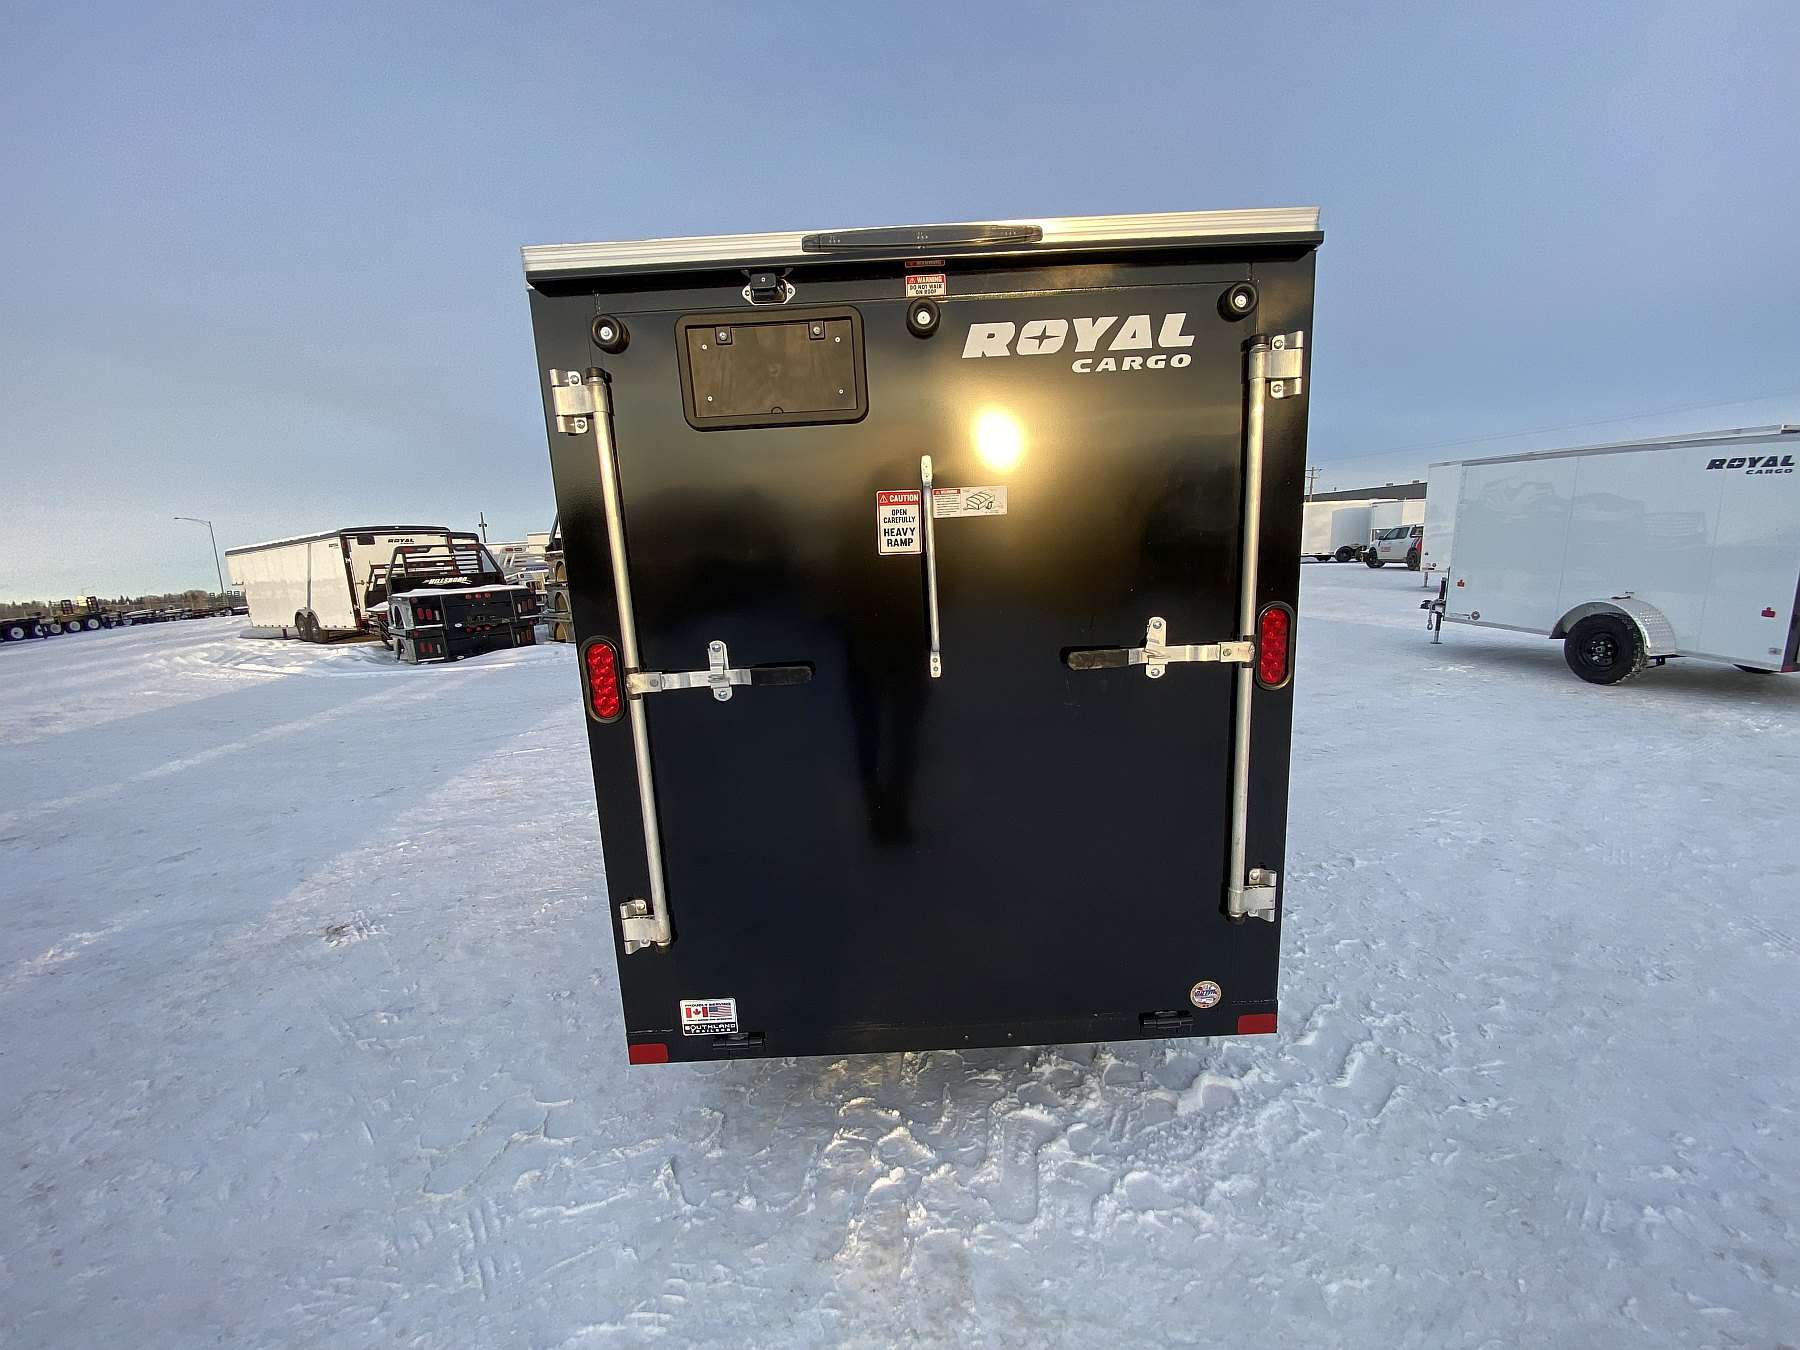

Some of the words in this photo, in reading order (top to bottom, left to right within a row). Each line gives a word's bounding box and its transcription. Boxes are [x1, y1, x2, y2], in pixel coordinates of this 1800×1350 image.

[962, 313, 1195, 359] ROYAL
[1071, 353, 1192, 373] CARGO
[1706, 455, 1795, 470] ROYAL
[890, 494, 919, 502] CAUTION
[883, 528, 915, 536] HEAVY
[887, 538, 914, 547] RAMP
